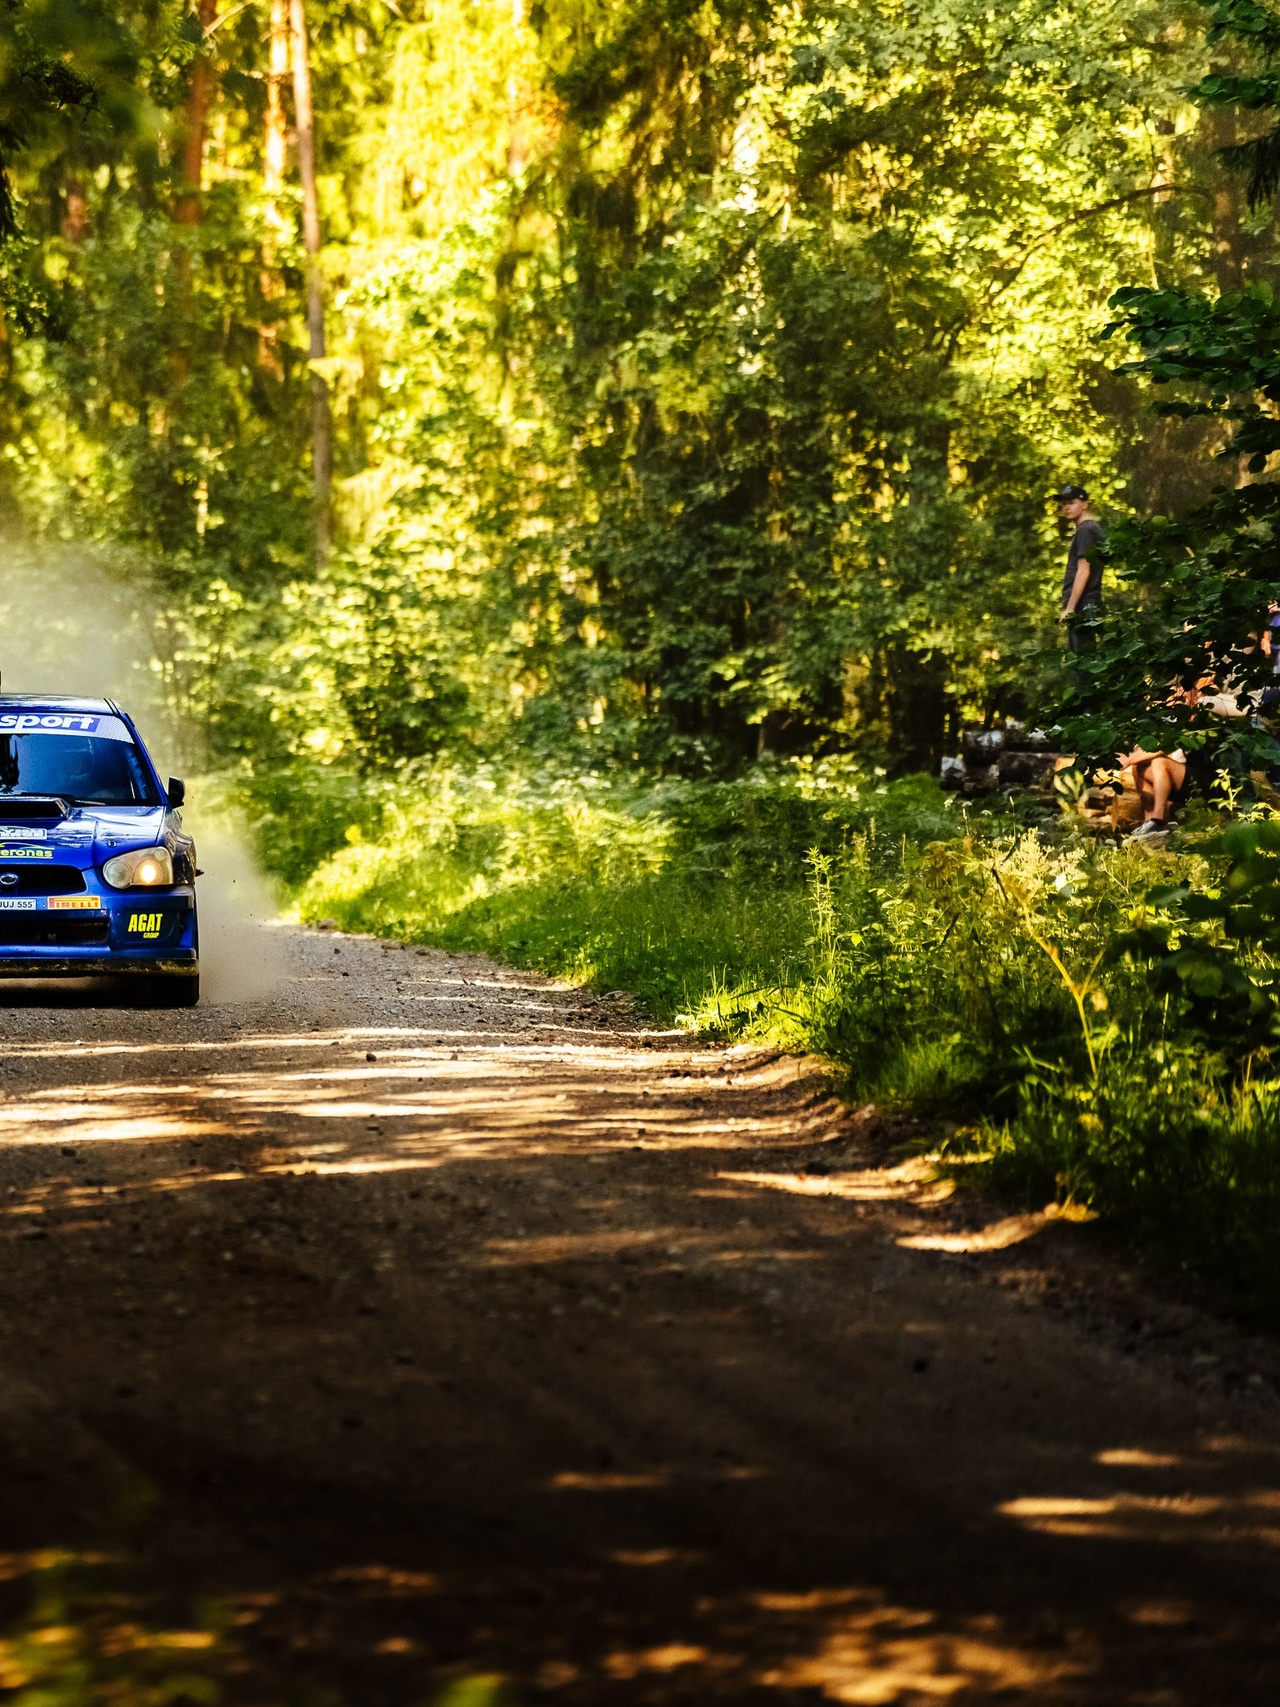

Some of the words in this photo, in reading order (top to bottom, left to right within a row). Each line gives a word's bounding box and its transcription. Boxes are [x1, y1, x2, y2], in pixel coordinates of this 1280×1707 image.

[17, 901, 33, 909] 555
[49, 896, 99, 908] PIRELLI
[127, 913, 163, 932] AGAT
